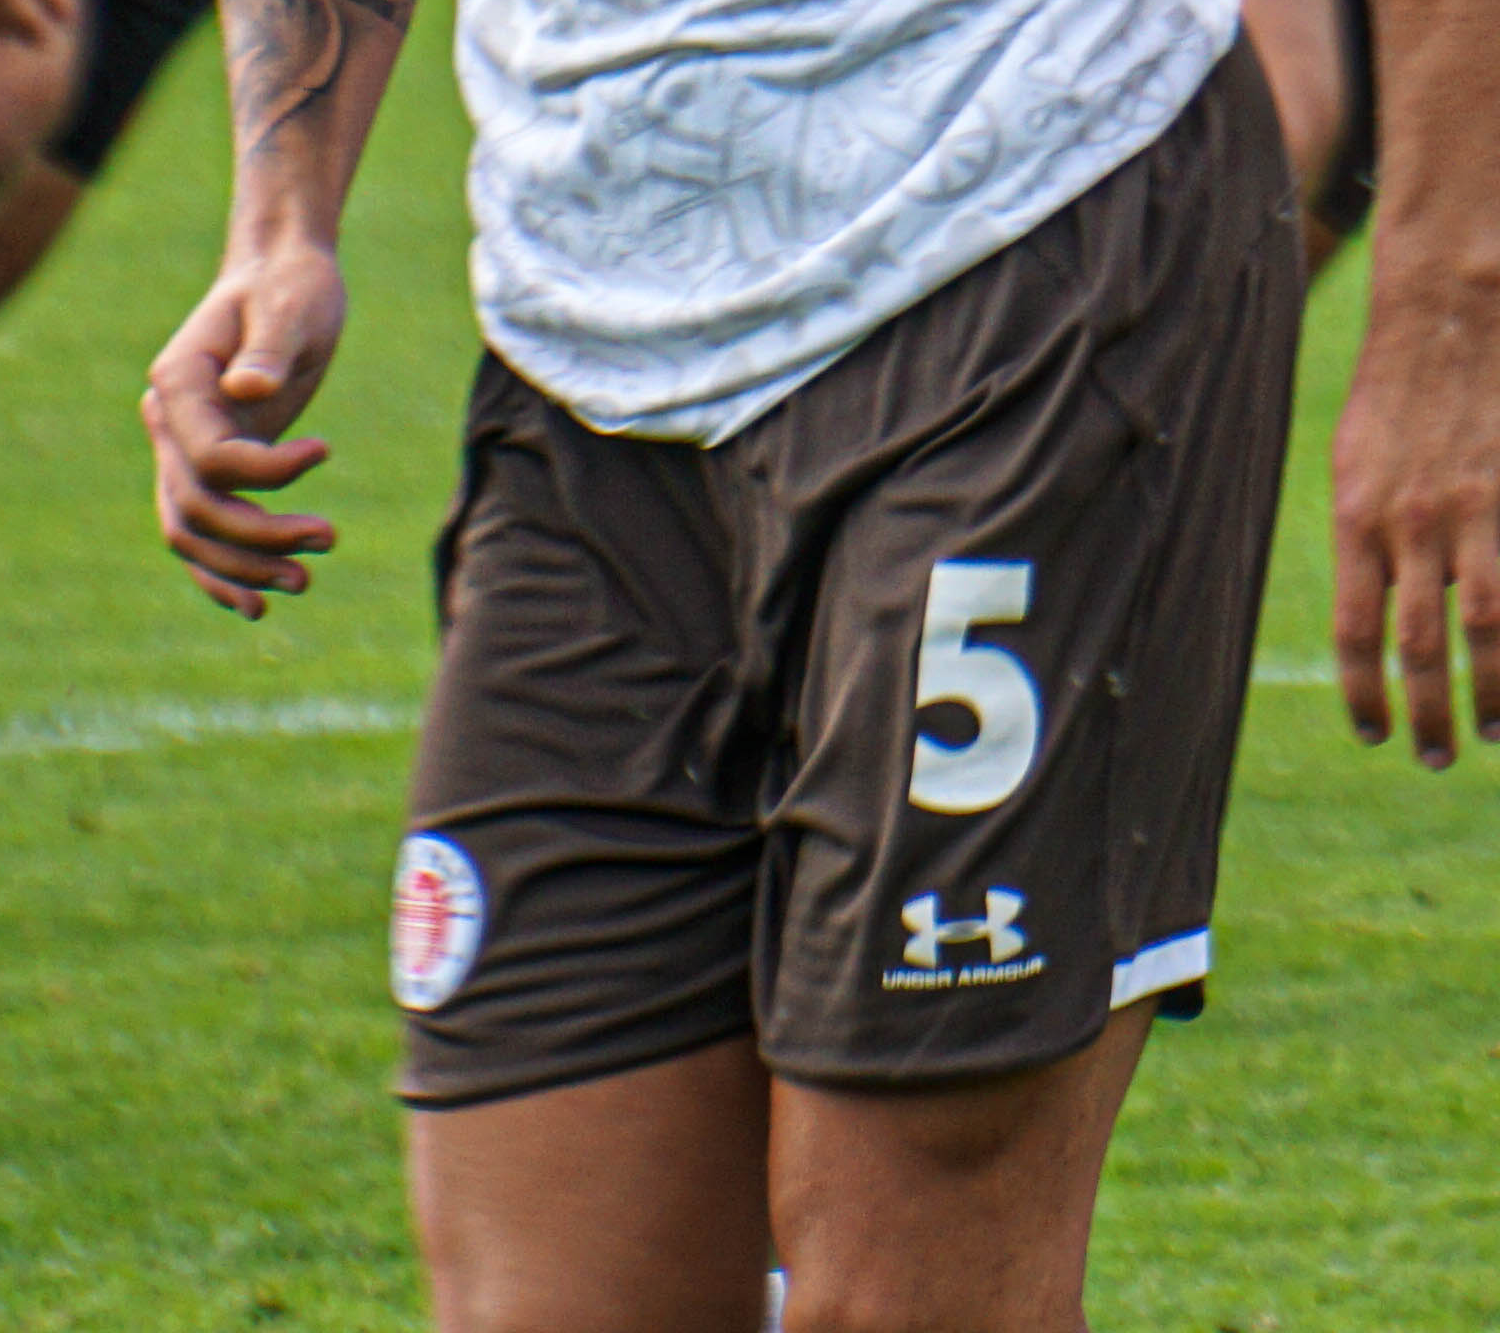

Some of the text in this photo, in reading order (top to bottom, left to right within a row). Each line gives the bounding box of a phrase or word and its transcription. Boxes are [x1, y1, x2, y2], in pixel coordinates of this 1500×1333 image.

[908, 558, 1044, 816] 5
[881, 953, 1046, 991] UNDER ARMOUR
